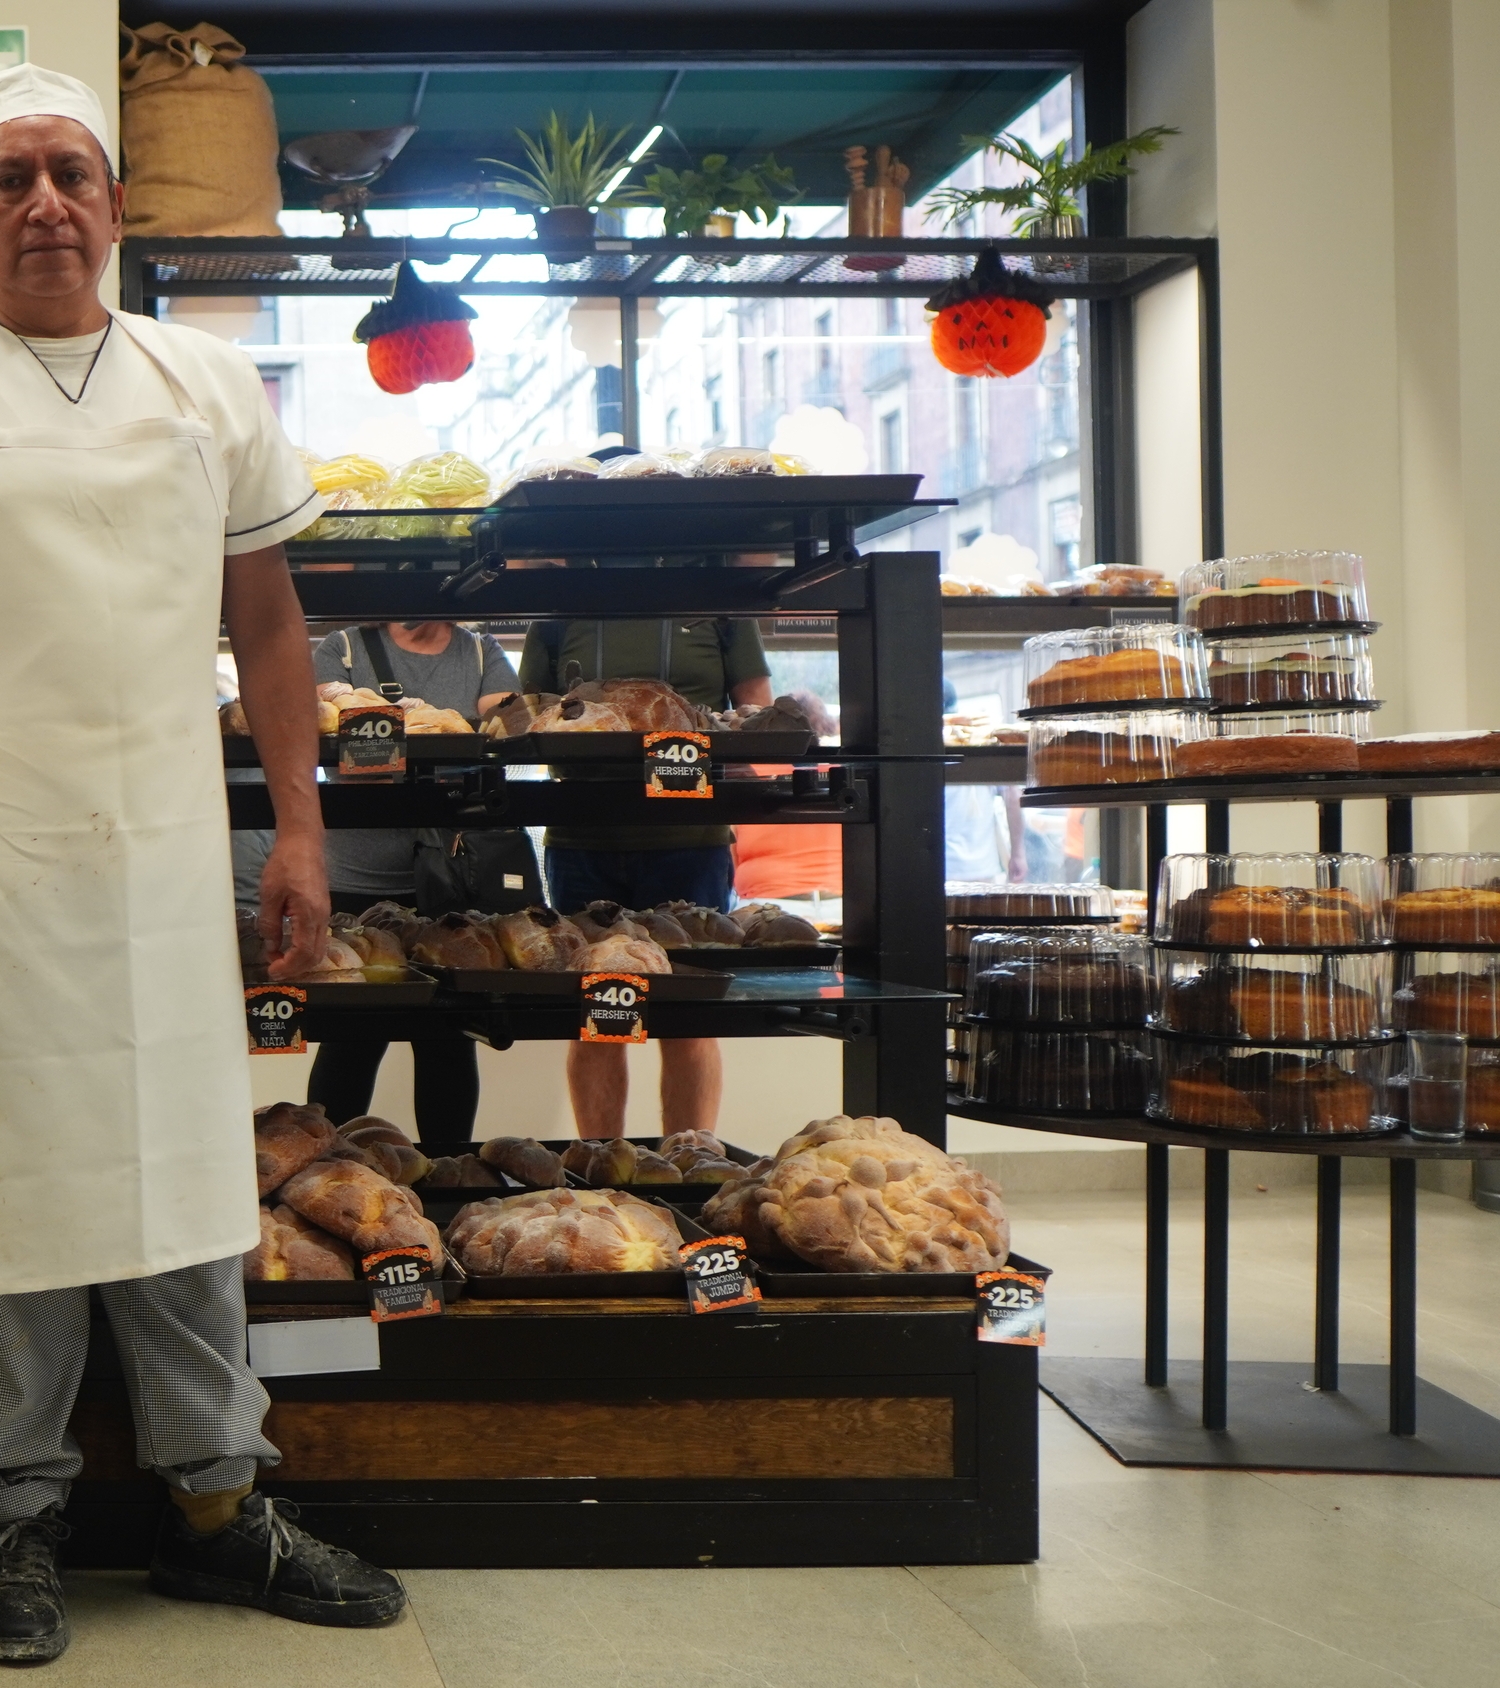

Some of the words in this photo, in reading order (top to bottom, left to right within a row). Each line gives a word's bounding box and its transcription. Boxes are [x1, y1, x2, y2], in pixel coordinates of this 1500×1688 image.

[351, 720, 392, 738] $40
[348, 738, 395, 747] PHILADELPHIA
[657, 744, 699, 763] $40
[655, 766, 703, 776] HERSHEY'S
[594, 986, 636, 1006] $40
[252, 1000, 294, 1020] $40
[591, 1009, 639, 1020] HERSHEY'S
[260, 1021, 286, 1030] CREMA
[261, 1036, 286, 1046] NATA
[693, 1249, 740, 1277] $225
[378, 1262, 420, 1285] $115
[698, 1271, 745, 1288] TRADICIONAL
[378, 1283, 426, 1298] TRADICIONAL
[709, 1283, 740, 1297] JUMBO
[987, 1286, 1034, 1309] $225
[385, 1293, 422, 1307] FAMILIAR
